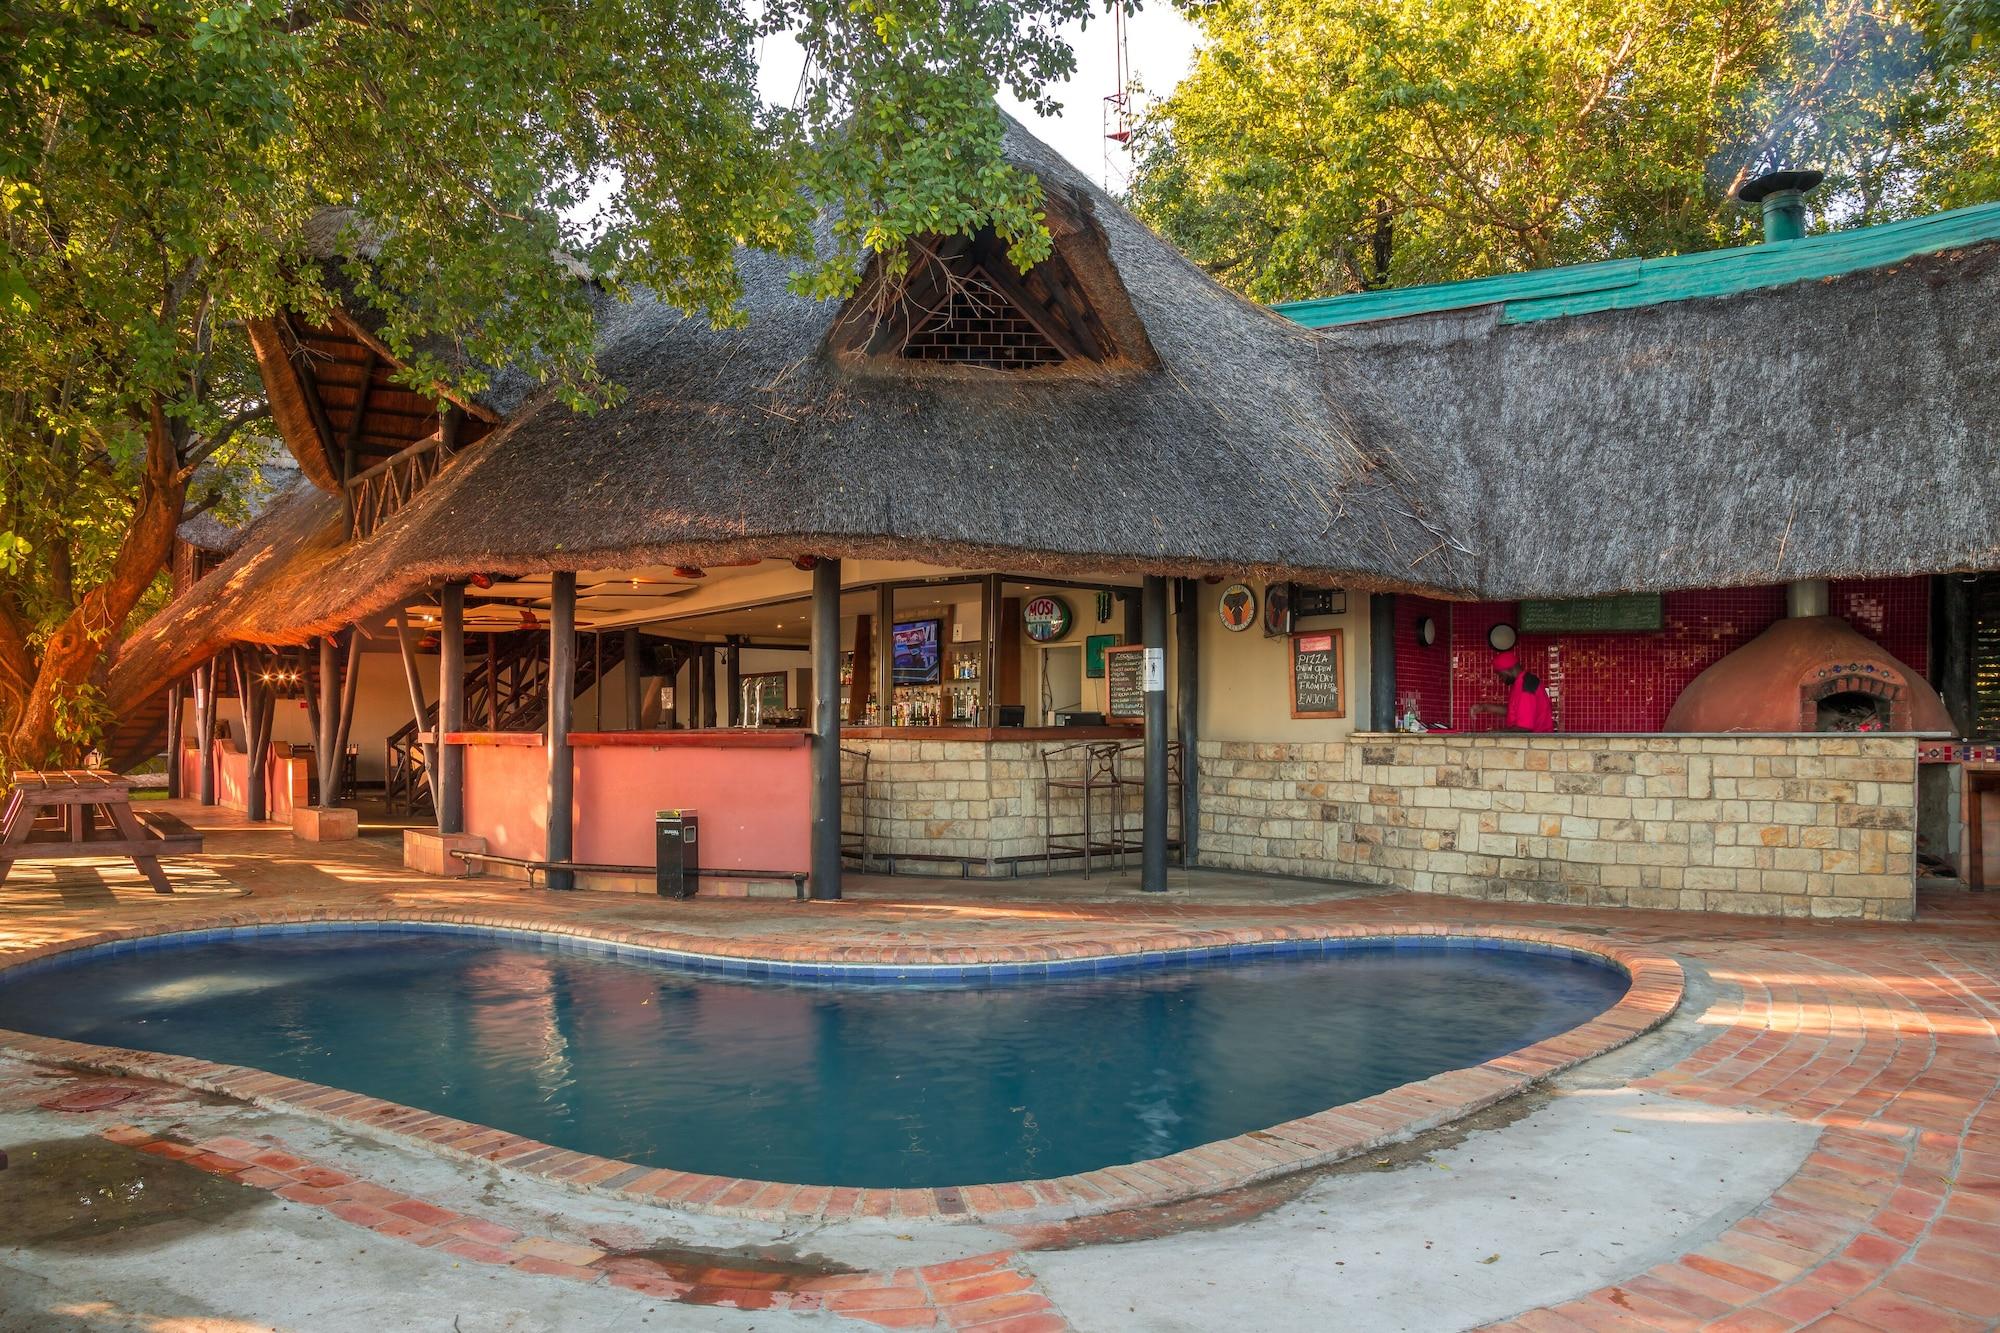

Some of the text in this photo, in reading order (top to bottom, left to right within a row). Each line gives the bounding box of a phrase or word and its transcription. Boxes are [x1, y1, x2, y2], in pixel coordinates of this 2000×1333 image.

[1029, 600, 1054, 616] MOSI
[1298, 653, 1328, 664] PIZZA
[1314, 664, 1331, 675] OPEN
